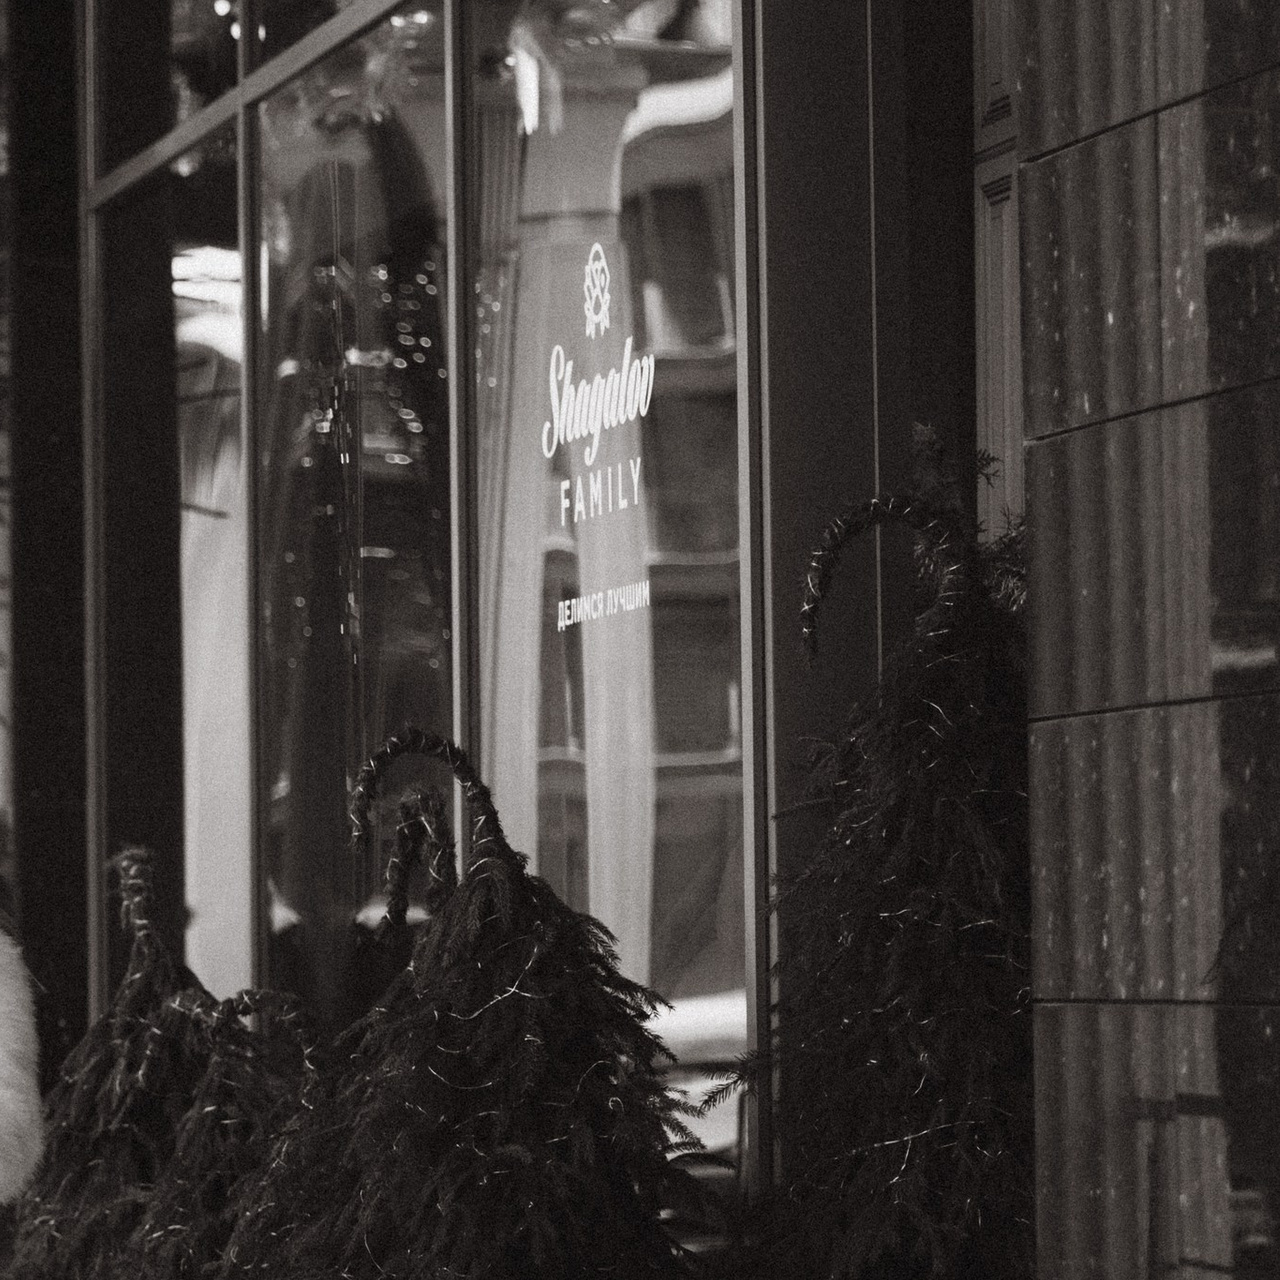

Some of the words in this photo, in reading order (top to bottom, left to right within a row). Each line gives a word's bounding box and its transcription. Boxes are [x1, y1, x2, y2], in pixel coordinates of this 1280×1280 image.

[542, 336, 655, 466] Shagalov
[561, 457, 641, 526] FAMILY
[558, 591, 604, 632] ДЕЛИМСЯ
[606, 580, 650, 616] ЛУЧШИМ
